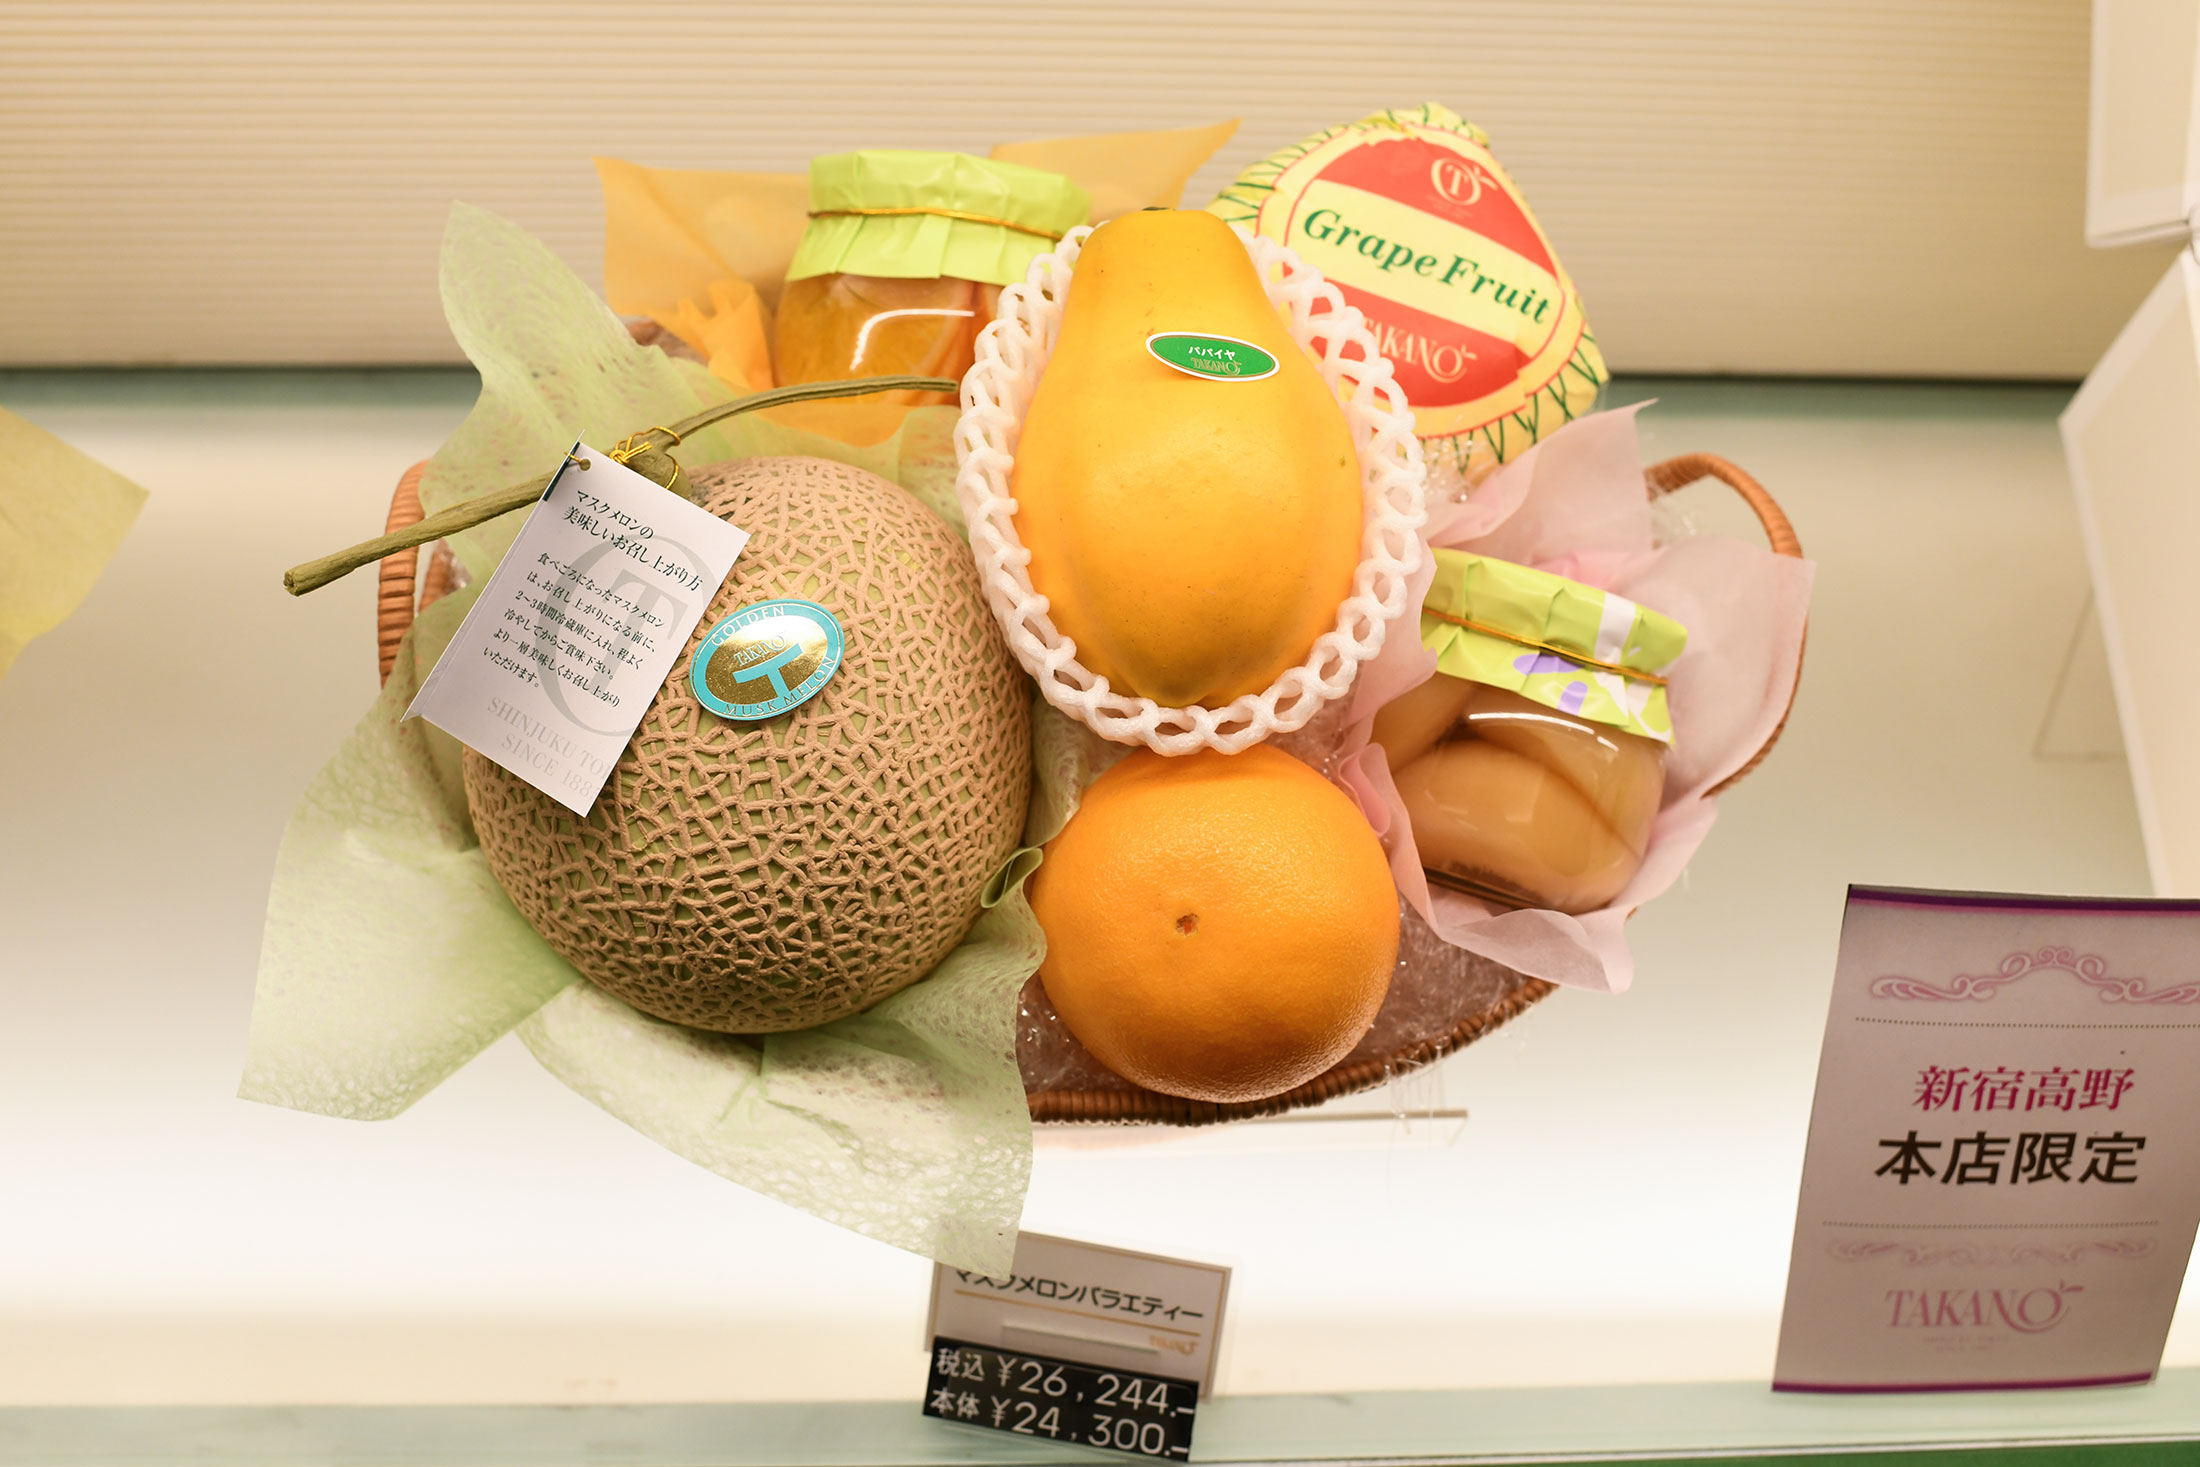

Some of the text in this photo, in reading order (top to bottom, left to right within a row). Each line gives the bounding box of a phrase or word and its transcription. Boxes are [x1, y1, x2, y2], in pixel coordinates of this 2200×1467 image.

[1303, 208, 1550, 324] Grape Fruit
[1191, 357, 1242, 376] TAKANO
[577, 490, 654, 539] マスクメロンの
[562, 506, 703, 592] 美味しいお召し上がり方
[527, 571, 655, 653] は、お召し上がりになる前に、
[537, 552, 664, 628] 食べごろになったマスクメロン
[504, 608, 614, 680] 冷やしてからご賞味下さい。
[711, 605, 785, 646] GOLDEN
[733, 634, 787, 666] TAKANO
[483, 647, 539, 688] いただけます。
[493, 628, 621, 708] より一層美味しくお召し上がり
[723, 656, 835, 716] MUSK MELON
[487, 697, 577, 759] SHINJUKU
[501, 733, 601, 800] SINCE 188
[1912, 1066, 2135, 1112] 新宿高野
[1875, 1130, 2146, 1185] 本店限定
[1884, 1280, 2084, 1334] TAKANO
[936, 1348, 985, 1382] 税込
[930, 1387, 980, 1419] 本体
